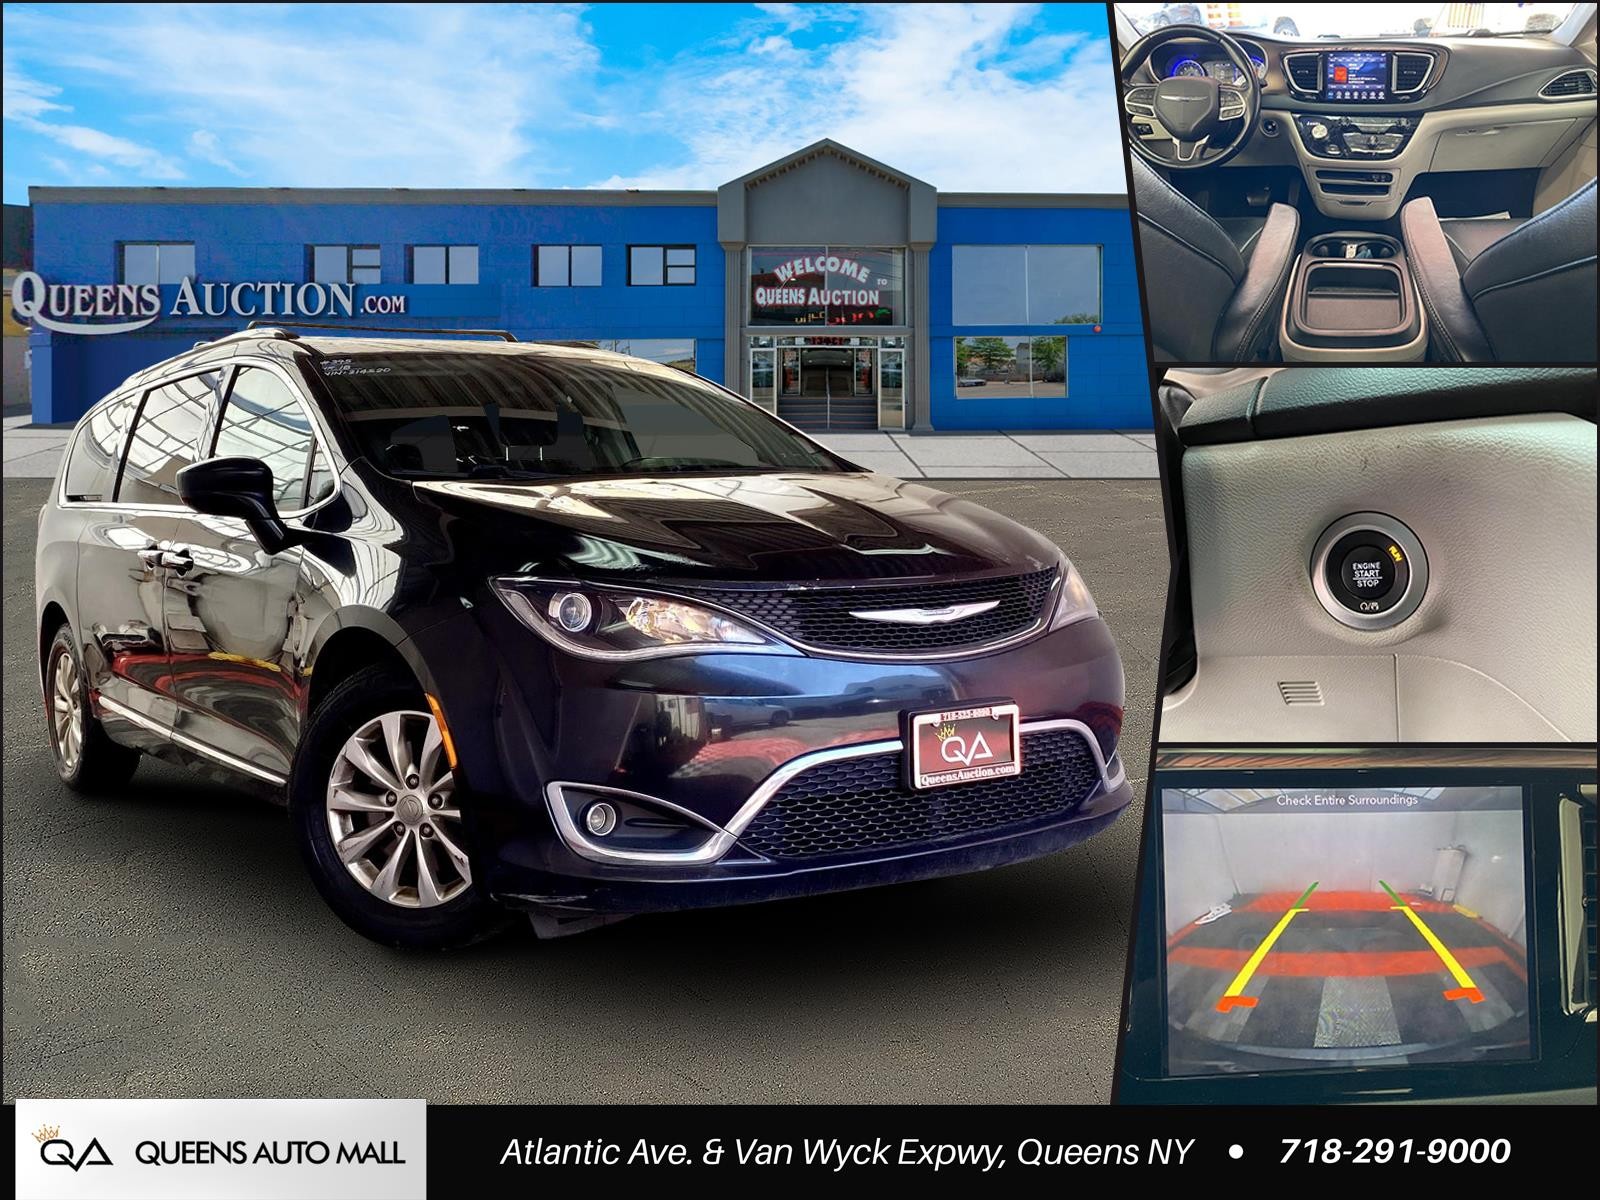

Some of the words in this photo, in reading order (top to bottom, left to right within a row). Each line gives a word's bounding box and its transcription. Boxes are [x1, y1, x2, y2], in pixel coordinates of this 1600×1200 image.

[774, 256, 871, 283] WELCOME
[877, 278, 888, 286] TO
[12, 271, 161, 335] QUEENS
[170, 276, 356, 317] AUCTION
[755, 287, 805, 305] QUEENS
[808, 287, 879, 305] AUCTION
[1388, 545, 1403, 562] RUN
[1352, 562, 1381, 570] ENGINE
[1357, 580, 1379, 588] STOP
[921, 765, 1016, 785] QueensAuction.com
[1276, 794, 1312, 806] Check
[1314, 795, 1346, 806] Entire
[1348, 794, 1419, 807] Surroundings
